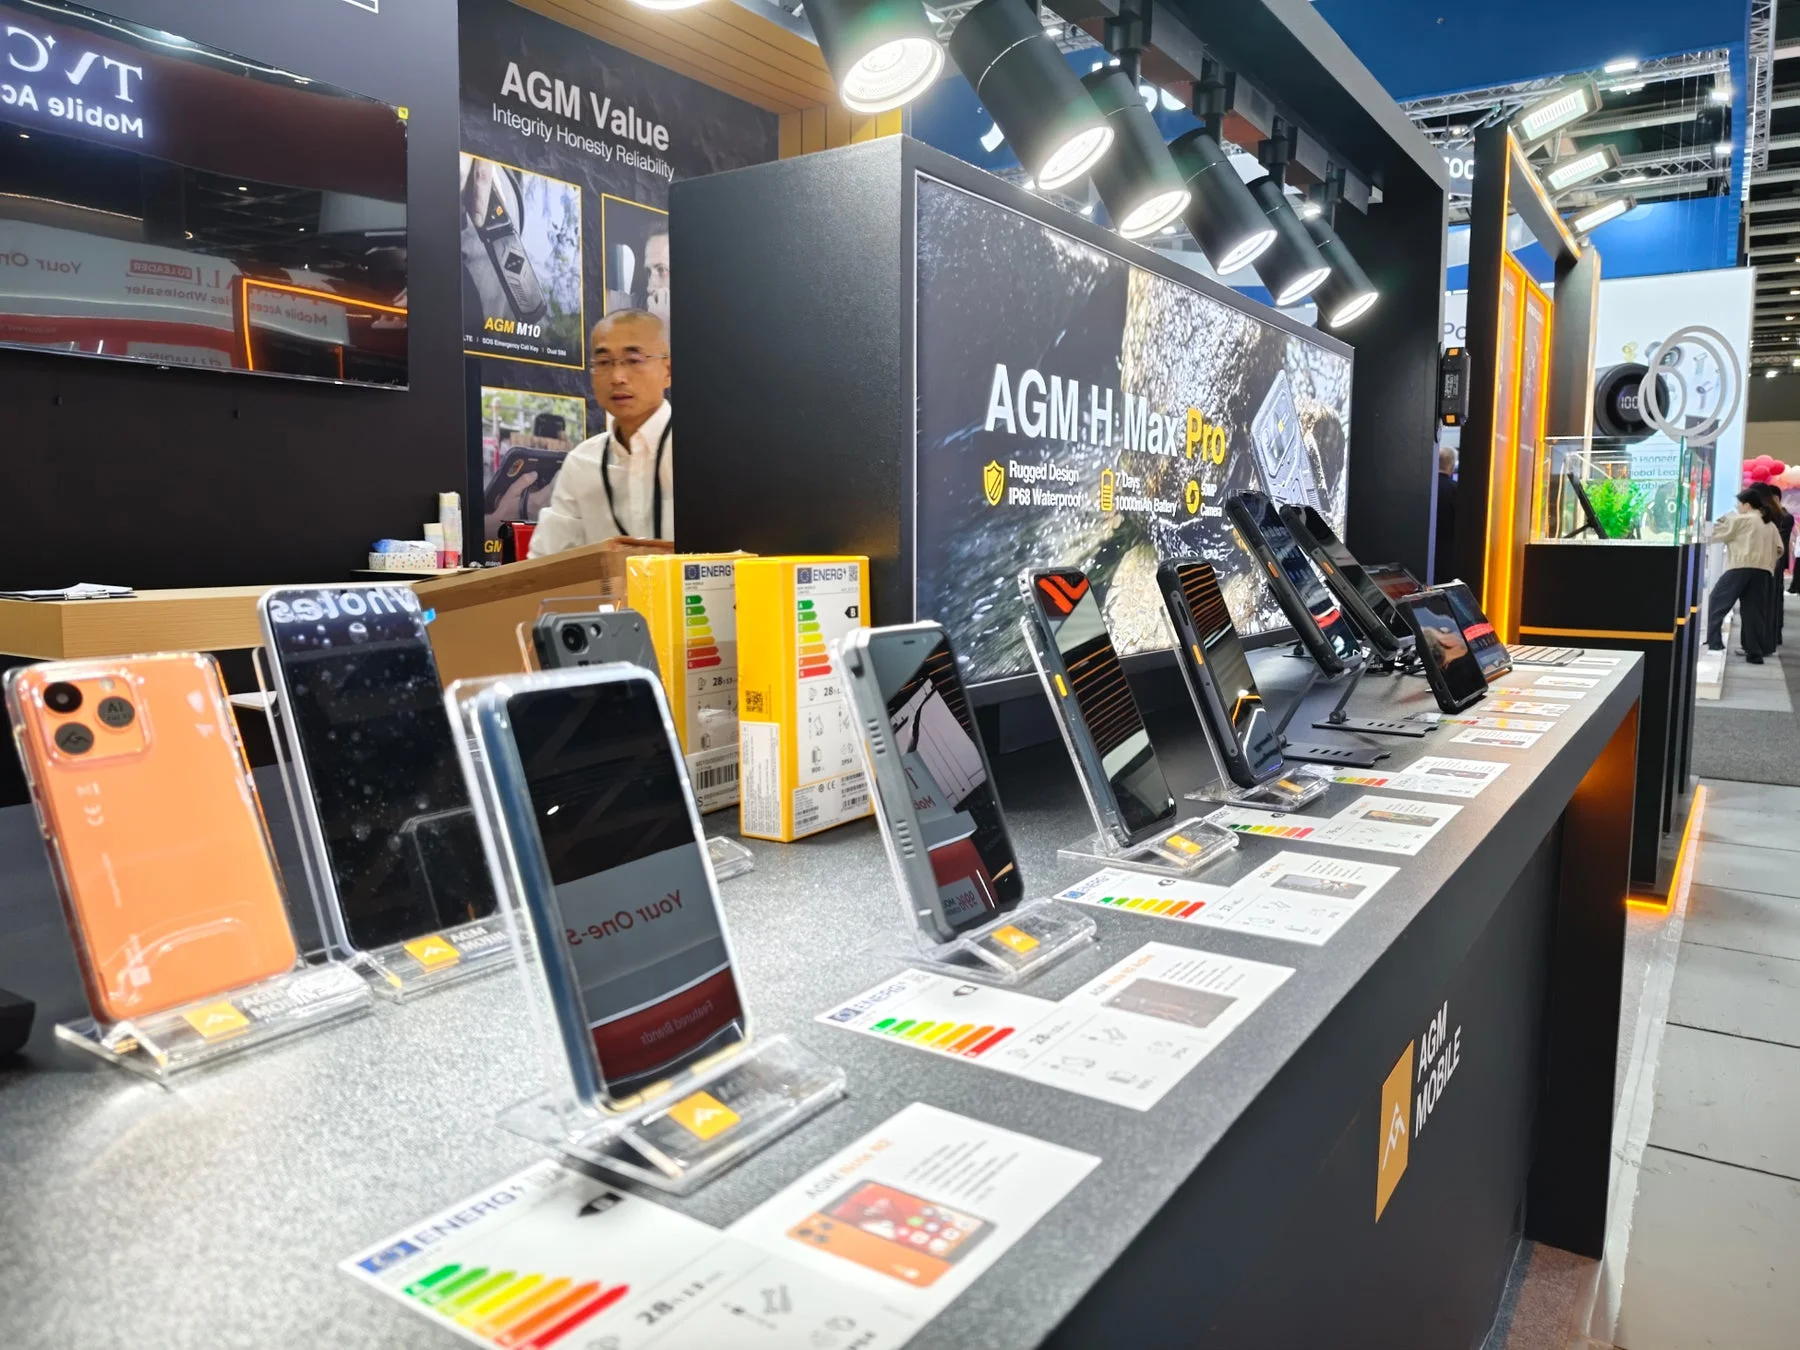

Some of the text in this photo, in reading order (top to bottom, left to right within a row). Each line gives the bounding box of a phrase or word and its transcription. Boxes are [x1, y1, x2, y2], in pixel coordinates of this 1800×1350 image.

[501, 61, 669, 151] AGM Value
[493, 103, 675, 182] Integrity Honesty Reliability
[484, 316, 541, 338] AGM M10
[494, 339, 520, 351] Emergency
[547, 347, 557, 355] Dual
[985, 363, 1226, 465] AGM H Max Pro
[1009, 460, 1079, 487] Rugged Design
[1115, 473, 1141, 492] 7 Days
[1009, 486, 1082, 514] IP68 Waterproof
[1153, 499, 1178, 517] Battery
[1200, 504, 1223, 518] Camera
[701, 565, 731, 578] ENERG
[813, 568, 844, 581] ENERG
[1417, 1000, 1448, 1083] AGM
[1415, 1025, 1461, 1138] MOBILE
[413, 1191, 518, 1246] ENERG
